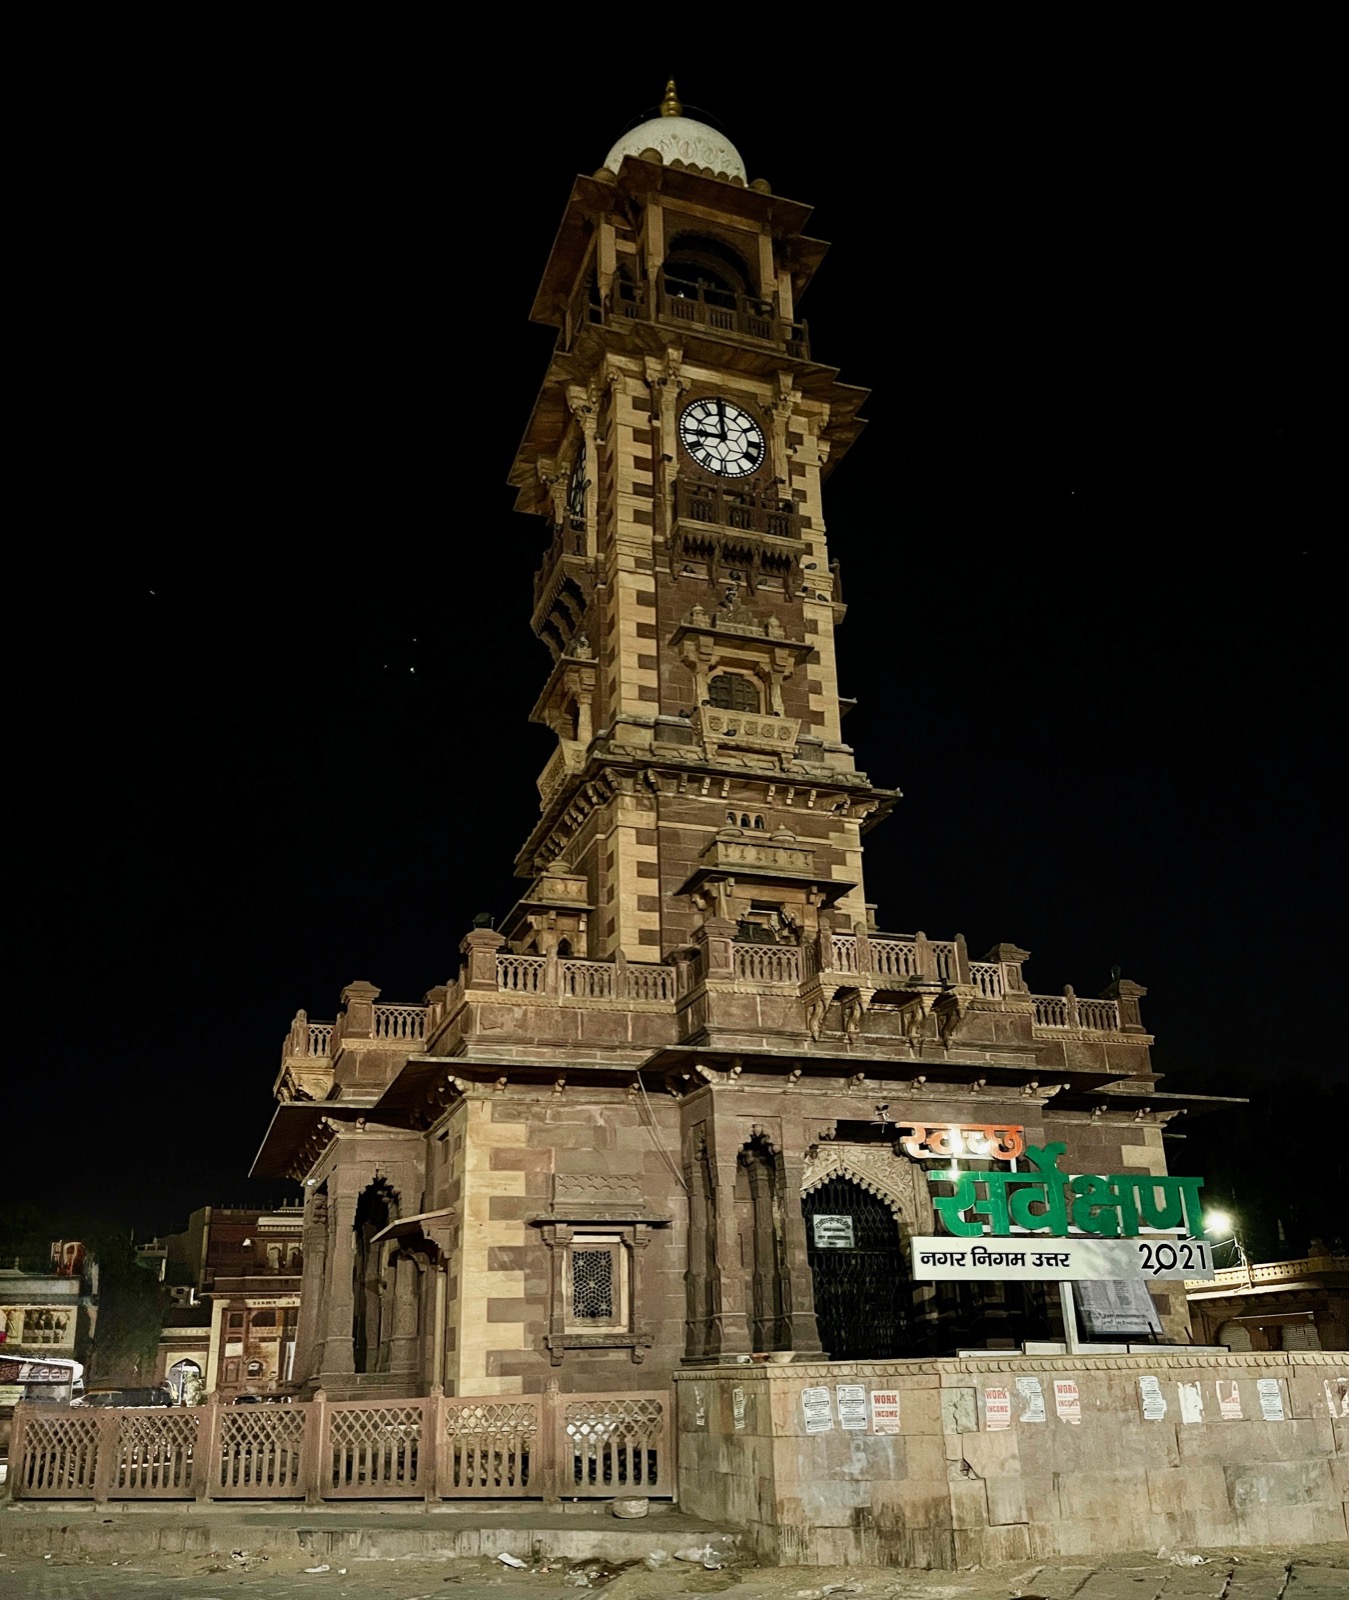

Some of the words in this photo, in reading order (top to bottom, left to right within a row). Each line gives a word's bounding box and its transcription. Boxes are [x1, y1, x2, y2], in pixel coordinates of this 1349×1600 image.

[895, 1122, 1025, 1160] स्वच्छ
[928, 1142, 1204, 1239] सर्वेक्षण
[920, 1251, 967, 1267] नगर
[970, 1246, 1026, 1268] निगम
[1031, 1252, 1071, 1268] उत्तर
[1138, 1243, 1207, 1275] 2021
[874, 1395, 898, 1404] WORK
[985, 1390, 1008, 1399] WORK
[874, 1410, 898, 1418] INCOME
[987, 1405, 1009, 1413] INCOME
